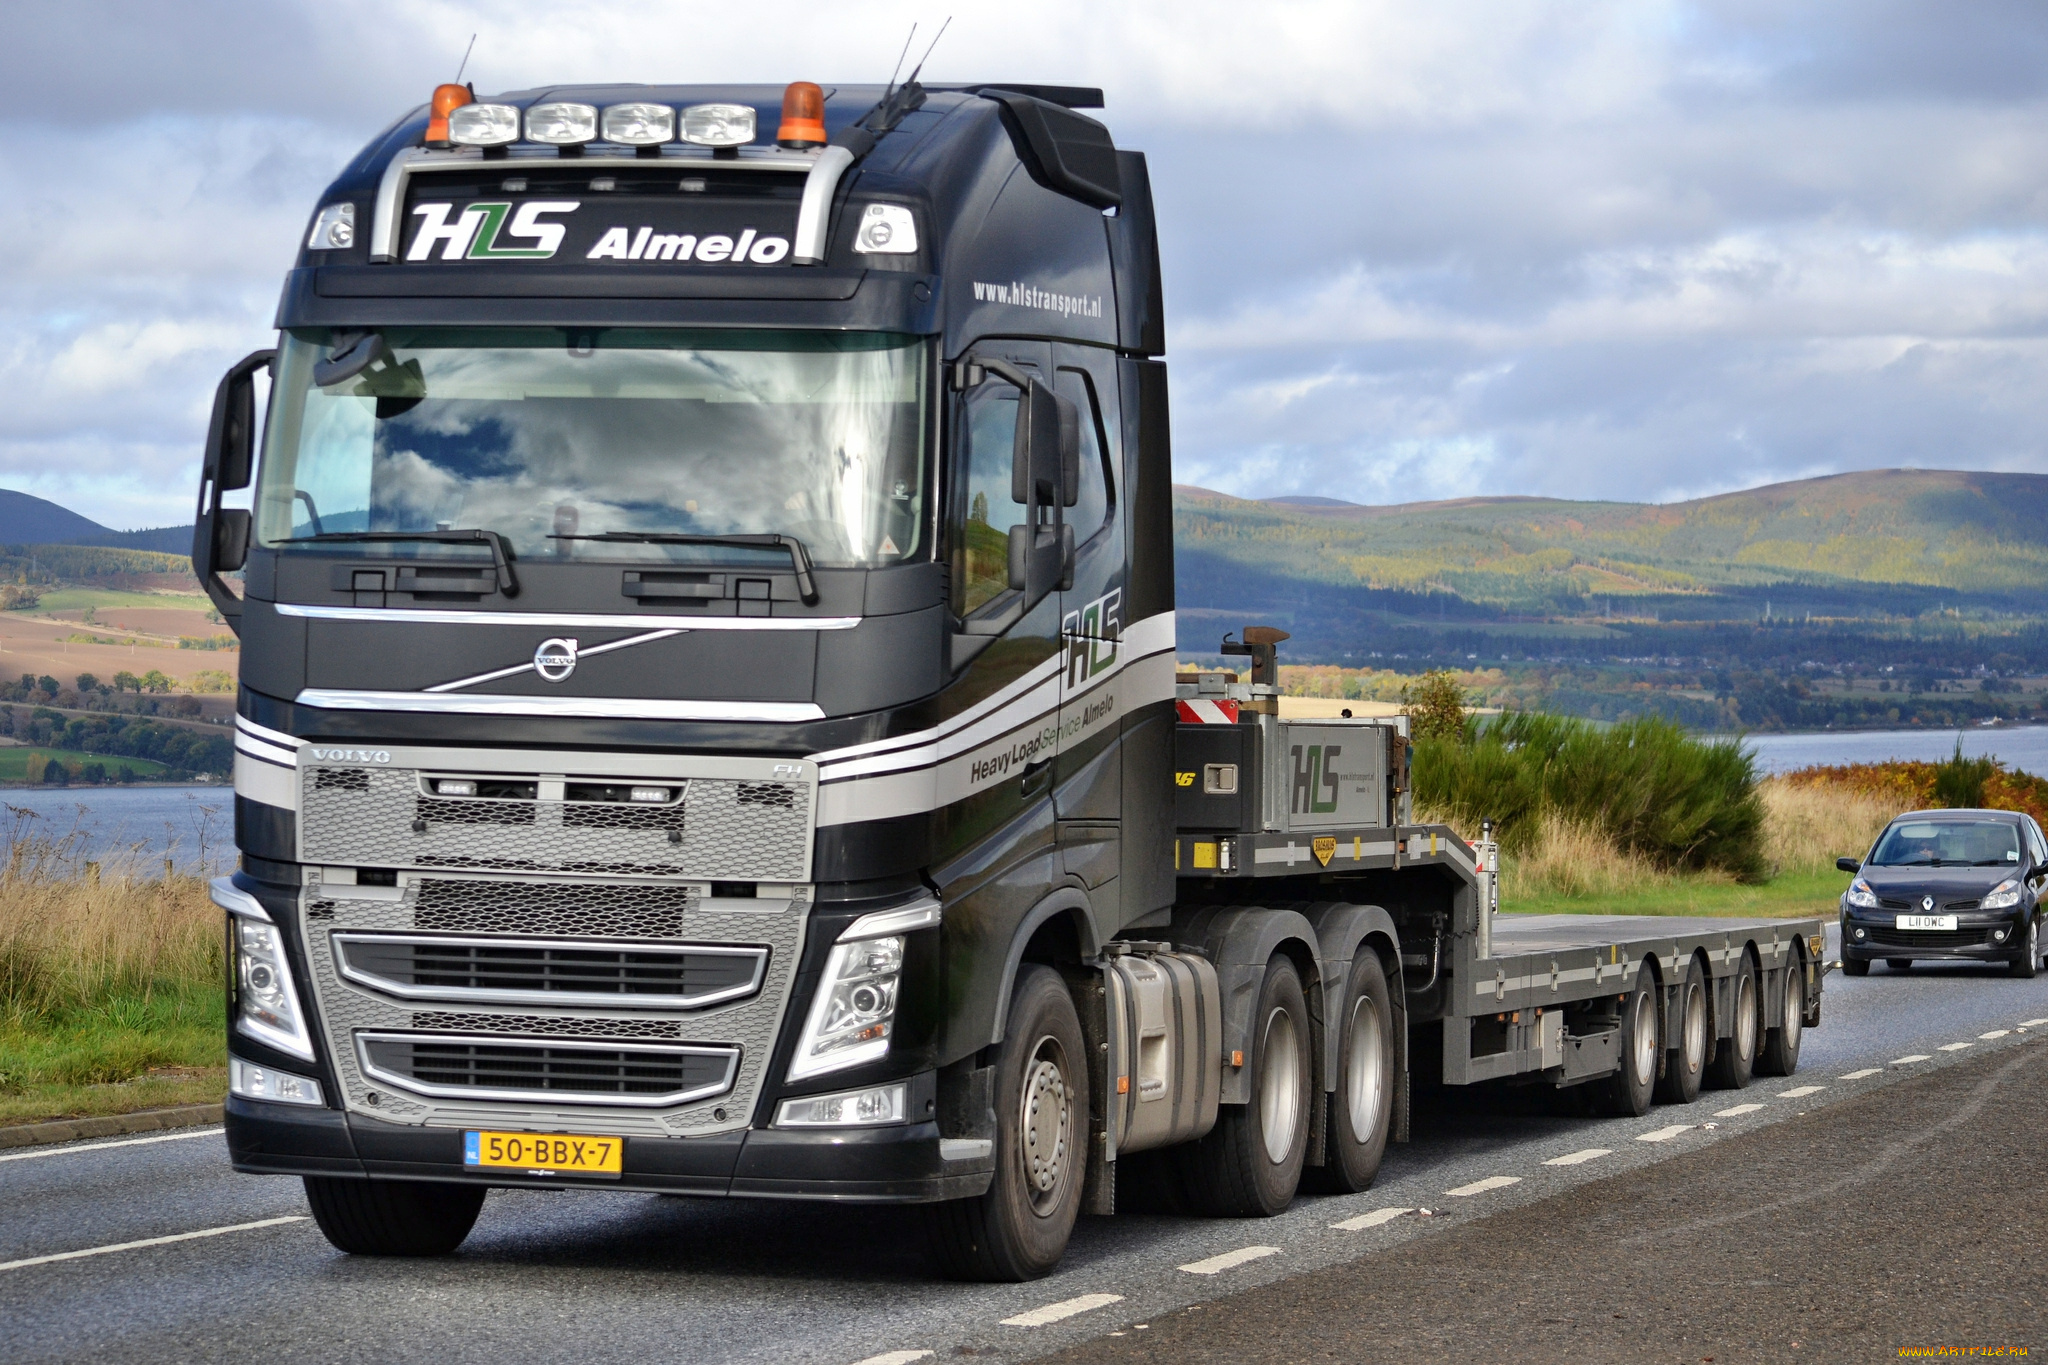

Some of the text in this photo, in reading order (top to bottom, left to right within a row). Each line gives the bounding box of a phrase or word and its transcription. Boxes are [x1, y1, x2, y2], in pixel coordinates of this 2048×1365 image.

[407, 201, 790, 264] HLS Almelo
[973, 281, 1102, 319] www.hlstransport.nl
[537, 657, 574, 665] VOLVO
[1082, 693, 1114, 728] Almelo
[311, 748, 391, 764] VOLVO
[772, 764, 803, 778] FH
[1291, 745, 1342, 814] HLS
[1924, 917, 1945, 927] OWC
[467, 1151, 478, 1160] NL
[489, 1137, 612, 1167] 50-BBX-7
